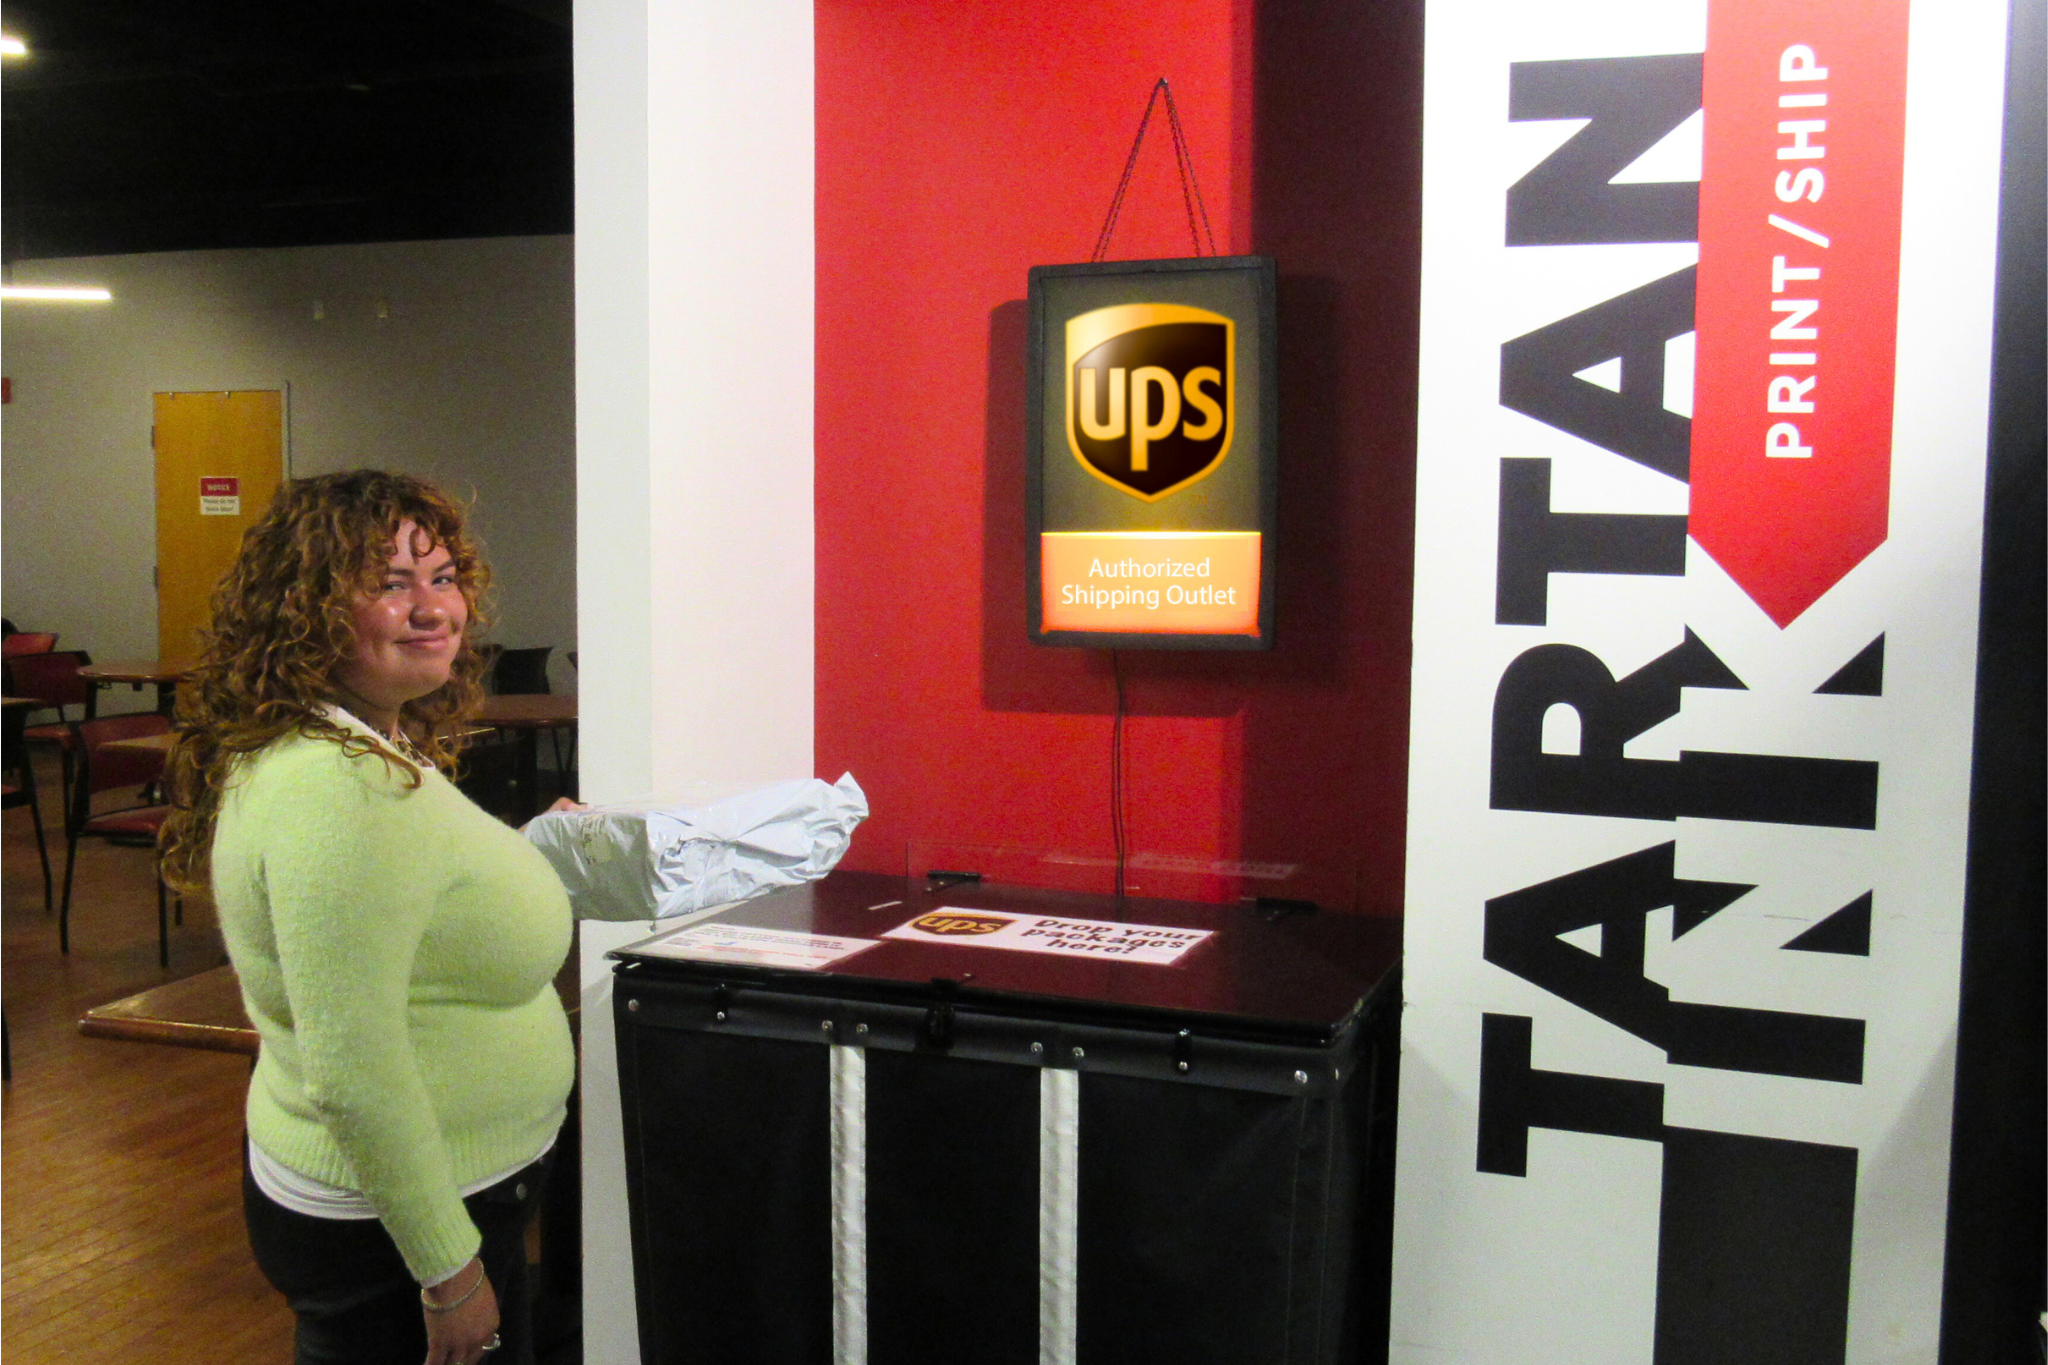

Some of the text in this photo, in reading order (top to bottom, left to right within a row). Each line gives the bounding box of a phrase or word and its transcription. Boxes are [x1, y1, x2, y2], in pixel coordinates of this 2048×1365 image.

[1766, 43, 1830, 459] PRINT/SHIP
[1079, 366, 1224, 471] ups
[1088, 557, 1210, 578] Authorized
[1061, 584, 1237, 610] Shipping Outlet
[1476, 52, 1706, 1178] TARTAN
[917, 915, 1003, 934] ups
[1034, 919, 1204, 940] Drop your
[1021, 928, 1186, 948] packages
[1045, 938, 1138, 954] here!
